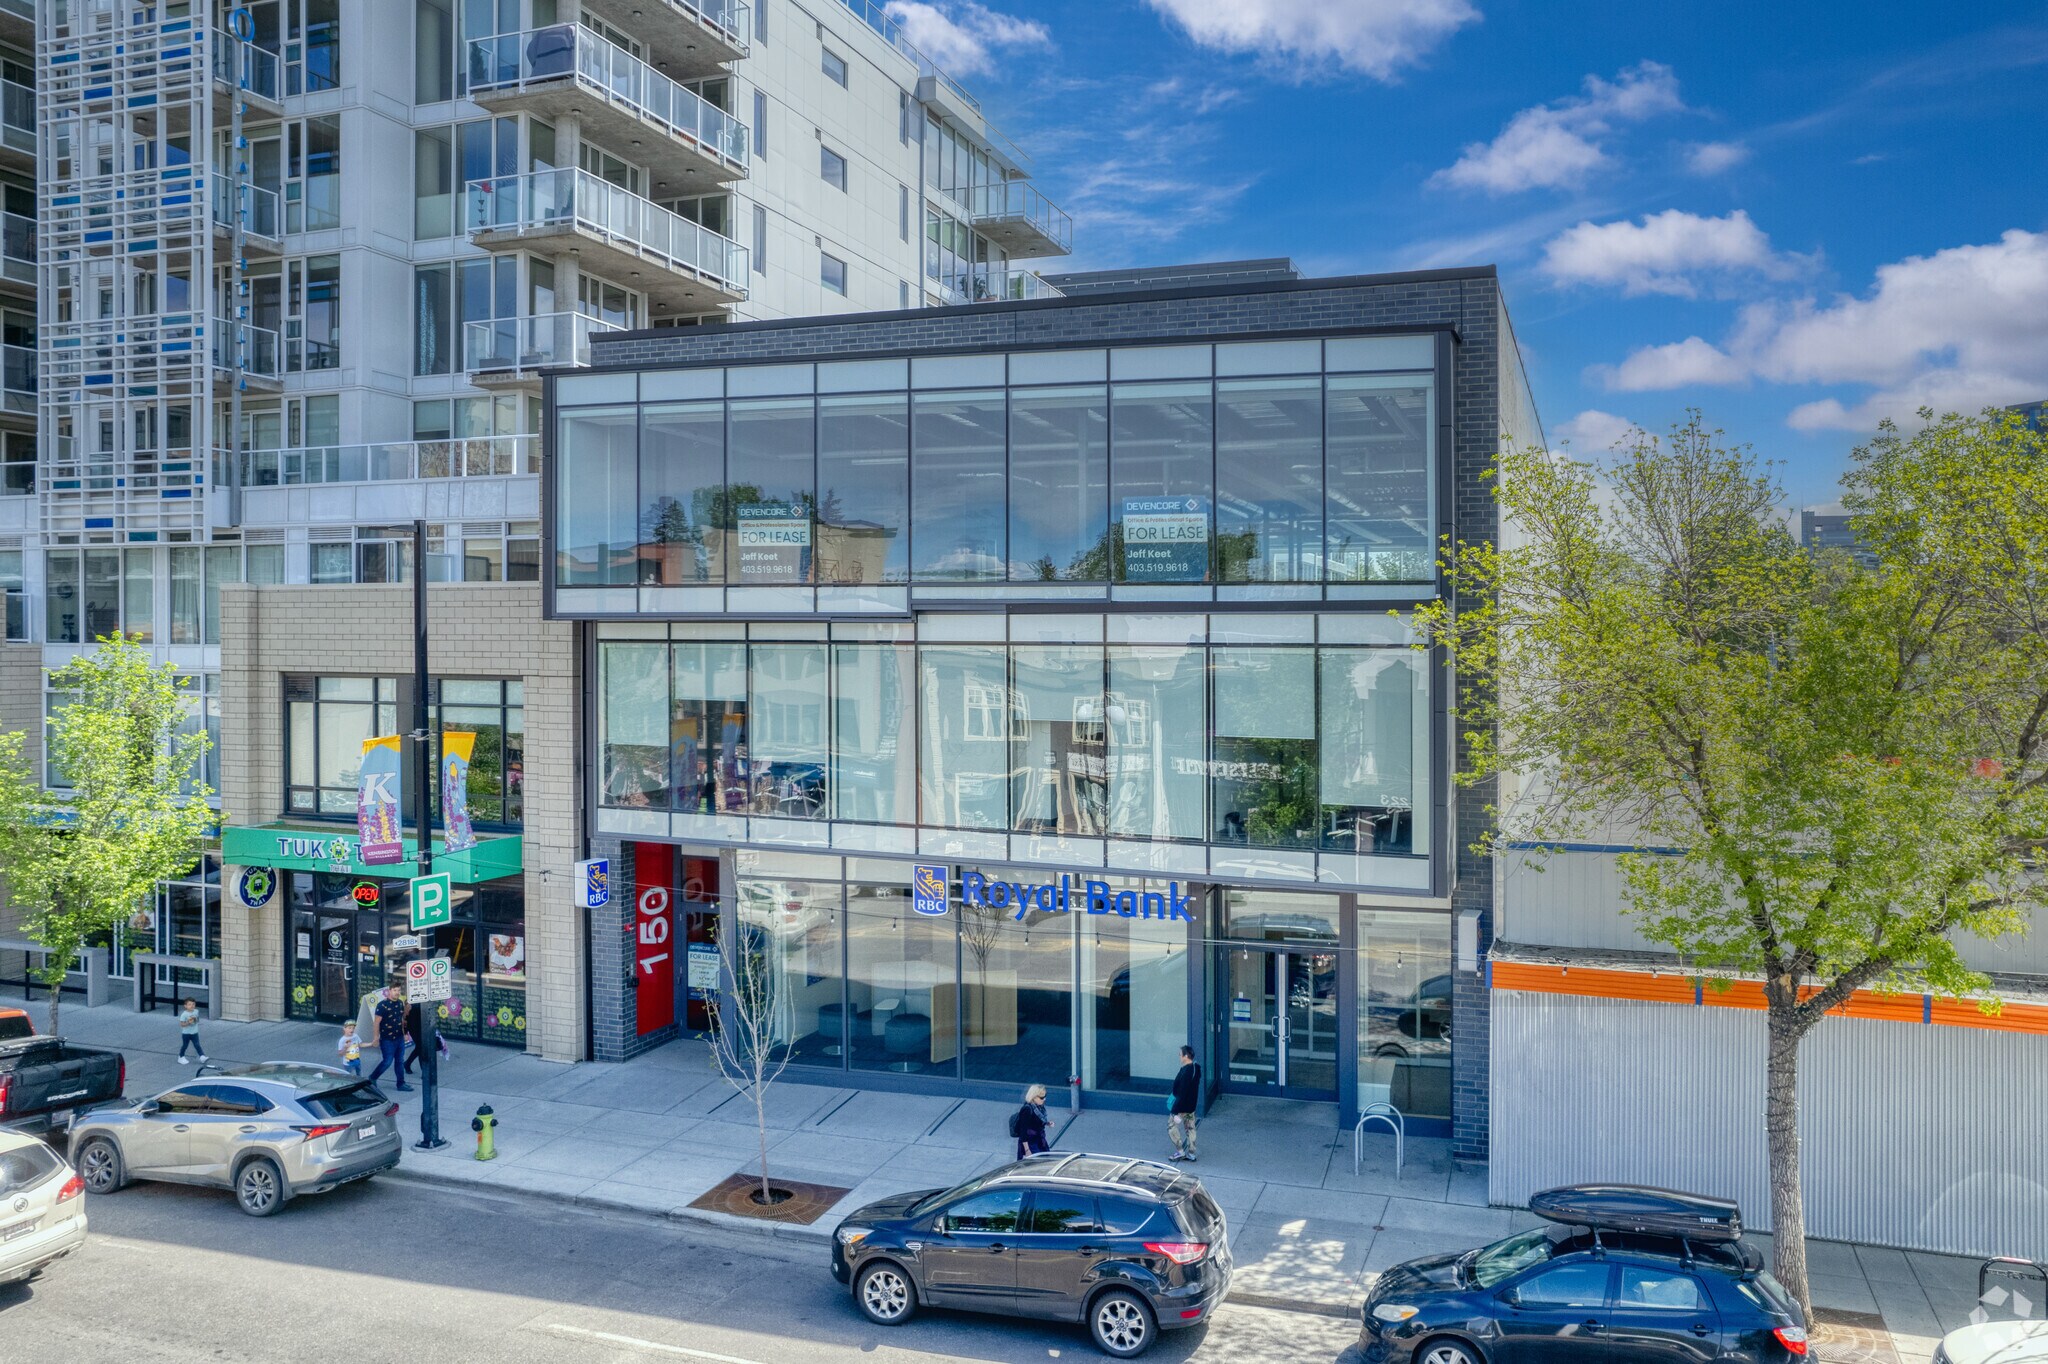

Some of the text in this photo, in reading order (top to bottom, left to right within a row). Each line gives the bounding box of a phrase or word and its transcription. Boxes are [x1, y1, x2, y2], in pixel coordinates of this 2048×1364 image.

[741, 508, 787, 516] DEVENCORE
[1126, 502, 1181, 511] DEVENCORE
[741, 531, 806, 543] FOR LEASE
[1128, 526, 1204, 540] FOR LEASE
[741, 552, 778, 560] Jeff Keet
[1127, 549, 1171, 558] Jeff Keet
[741, 565, 793, 573] 403.519.9618
[1127, 563, 1189, 572] 403.519.9618
[361, 772, 397, 807] K
[276, 837, 327, 859] TUK
[367, 848, 399, 856] KENSINGTON
[353, 887, 379, 901] OPEN
[589, 891, 607, 905] RBC
[961, 871, 1195, 923] Royal Bank
[250, 897, 266, 906] THAI
[418, 882, 443, 920] P
[917, 899, 944, 912] RBC
[639, 886, 669, 975] 150
[702, 953, 718, 961] LEASE
